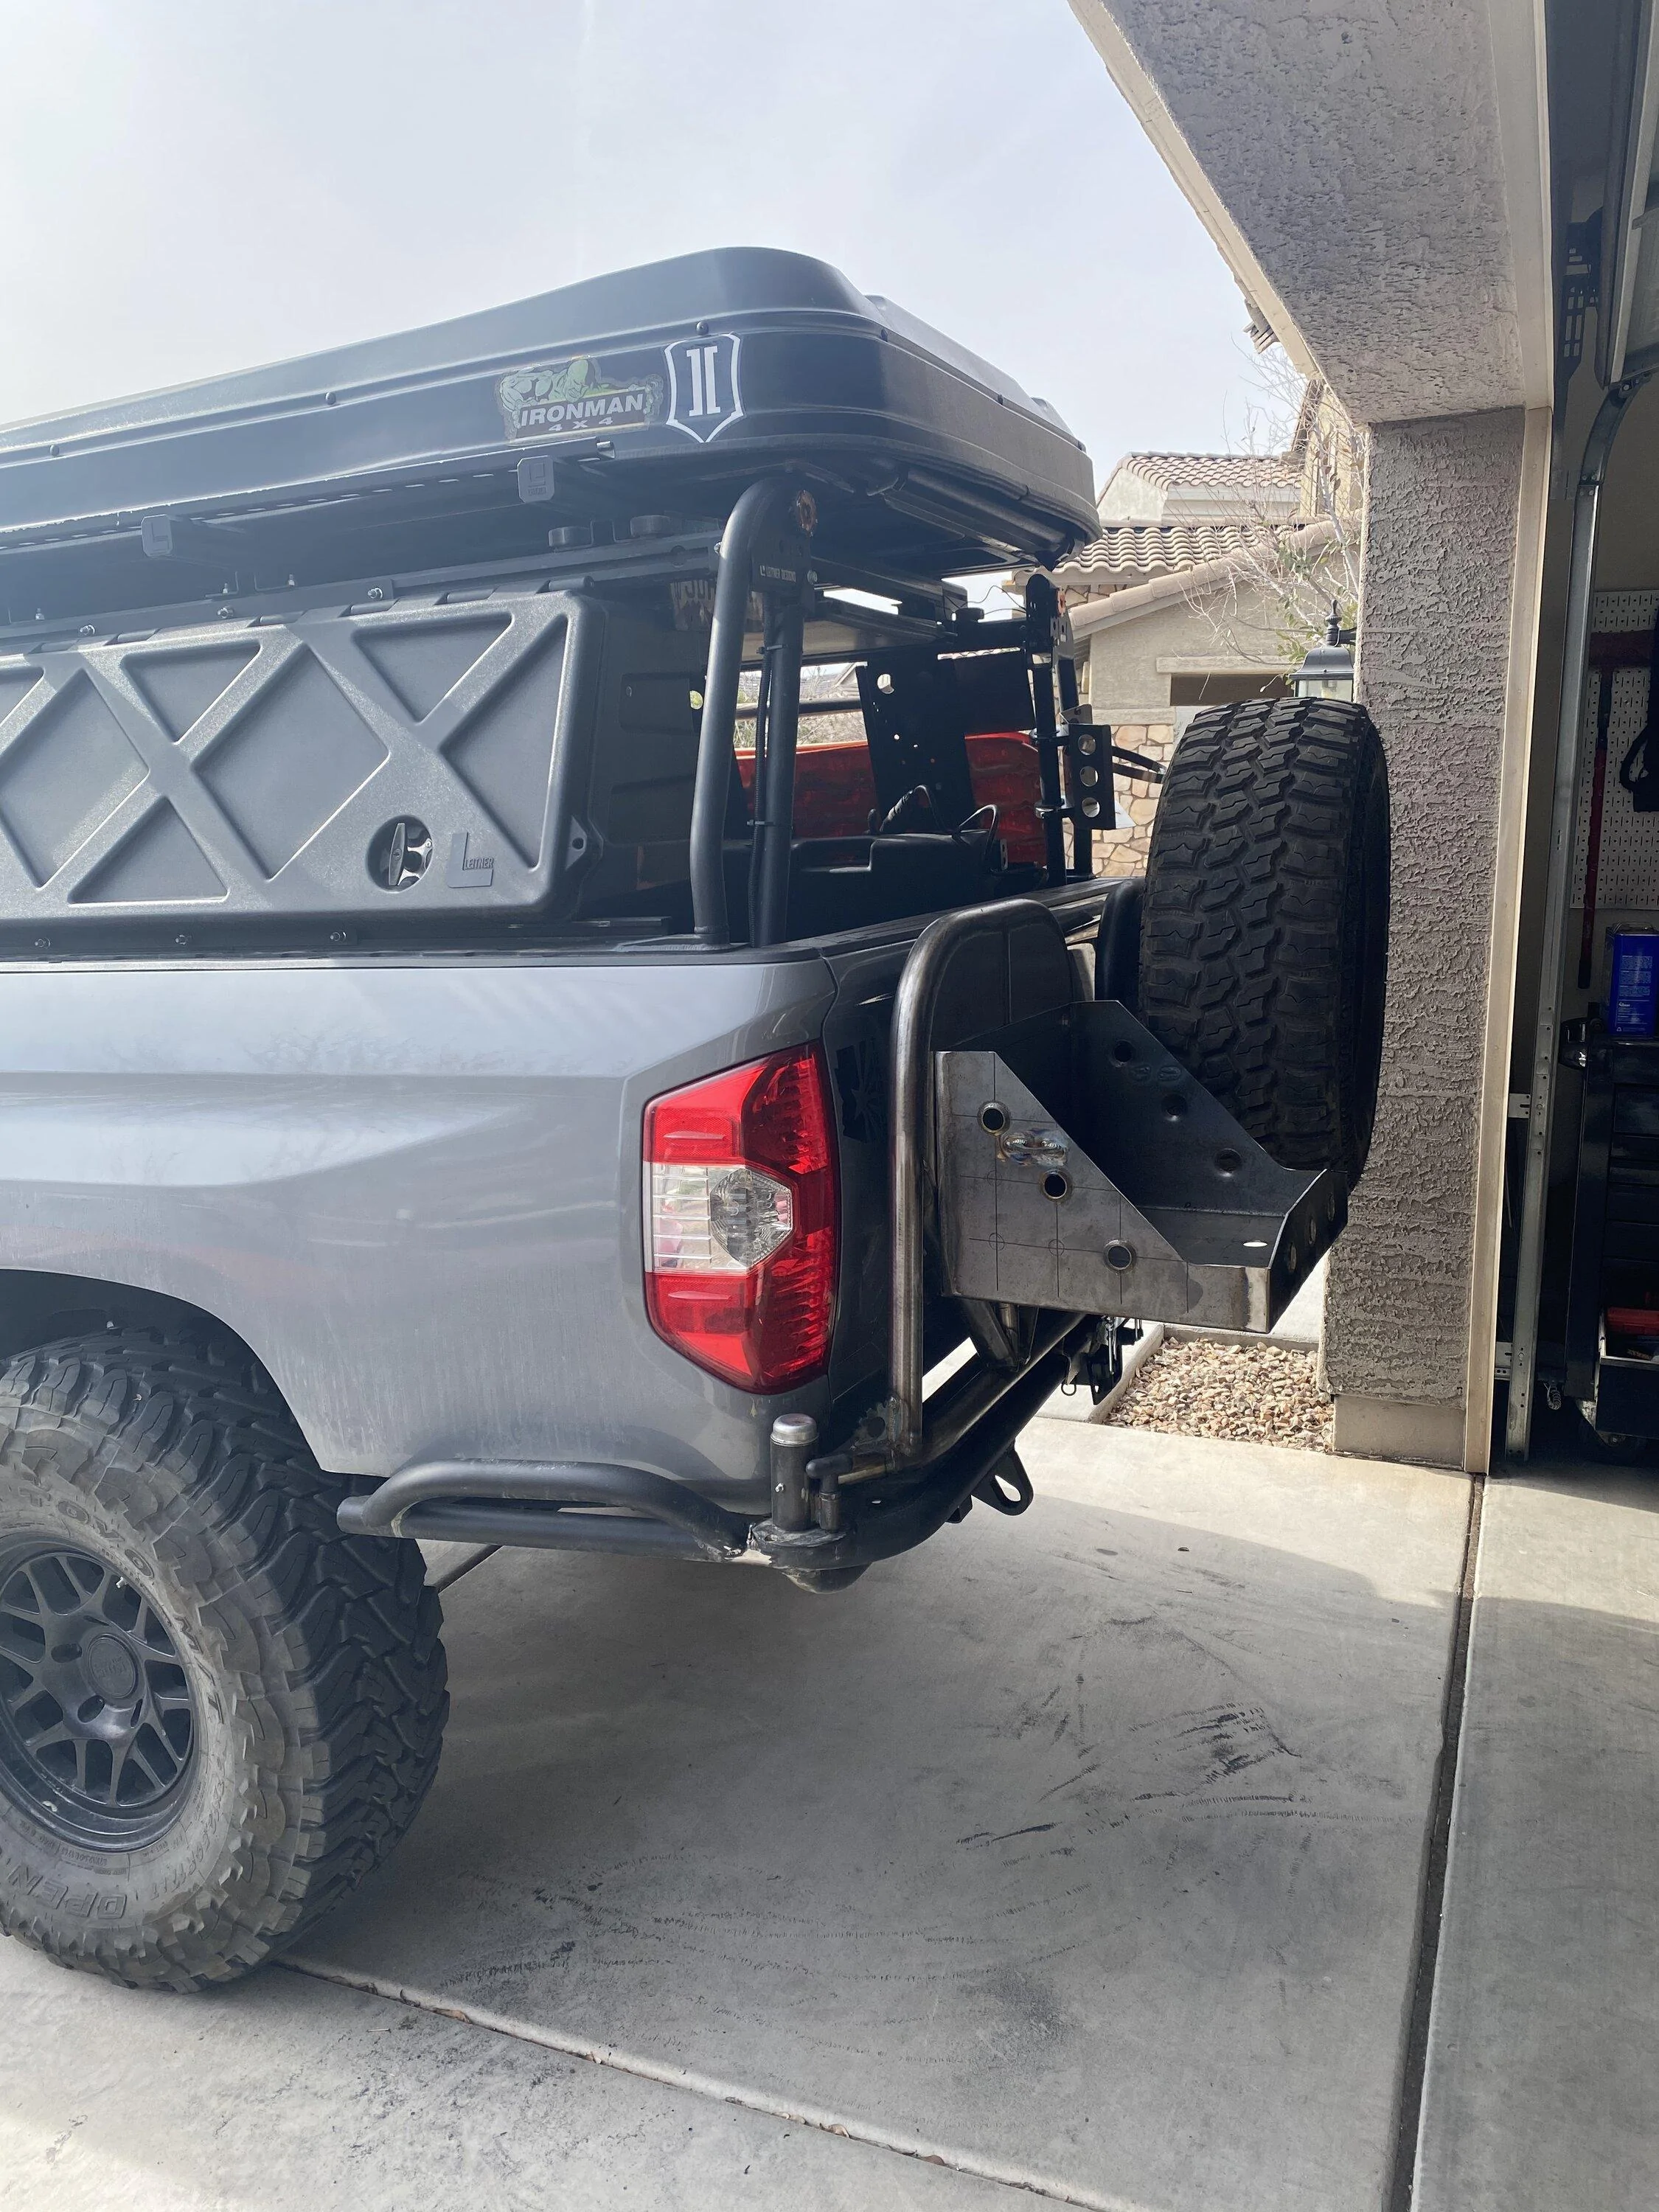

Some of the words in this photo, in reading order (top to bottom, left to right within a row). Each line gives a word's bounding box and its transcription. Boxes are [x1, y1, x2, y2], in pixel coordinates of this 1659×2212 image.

[520, 394, 644, 426] IRONMAN
[548, 423, 563, 432] 4
[598, 416, 613, 425] 4
[465, 858, 494, 870] LEITNER
[18, 1486, 155, 1579] TOYO
[6, 1865, 128, 1919] OPEN
